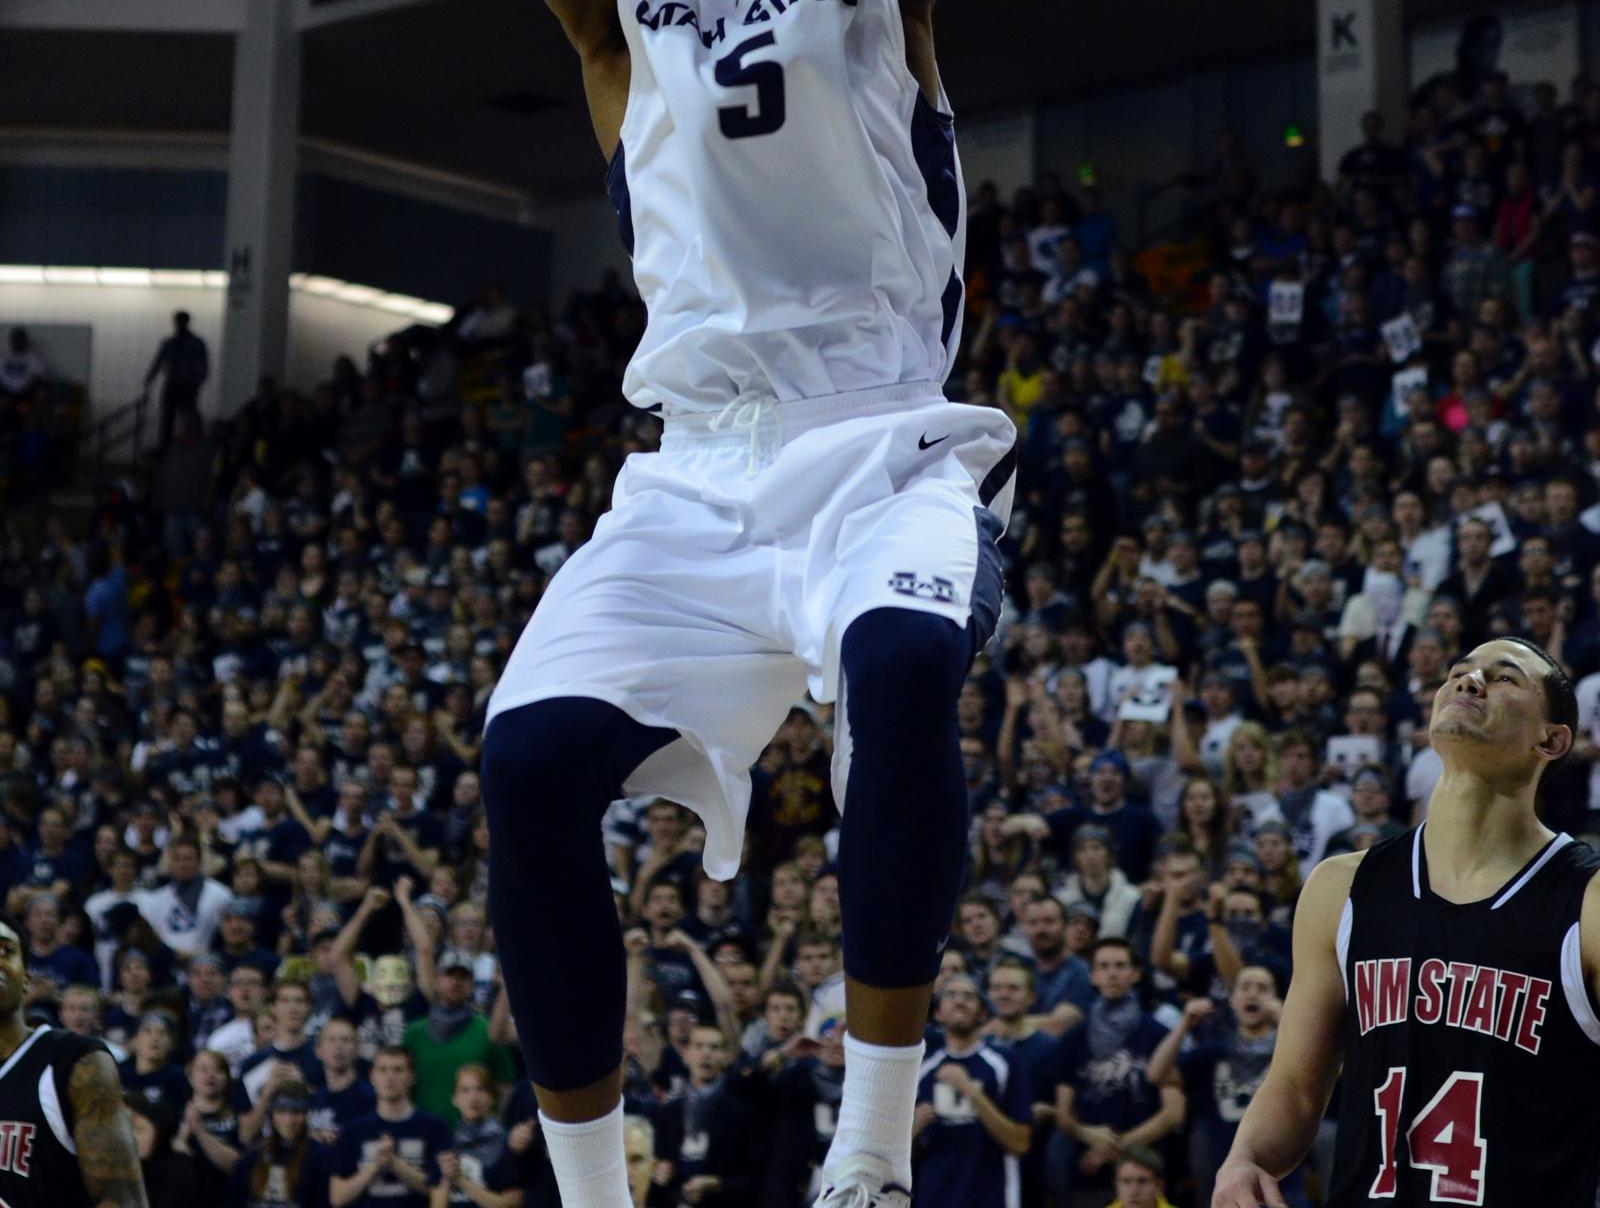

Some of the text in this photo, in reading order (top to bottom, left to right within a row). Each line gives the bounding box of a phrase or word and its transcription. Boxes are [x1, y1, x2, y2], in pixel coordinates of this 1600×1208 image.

[1332, 13, 1357, 50] K
[715, 29, 786, 140] 5
[1415, 958, 1553, 1055] STATE
[1369, 1066, 1488, 1207] 14
